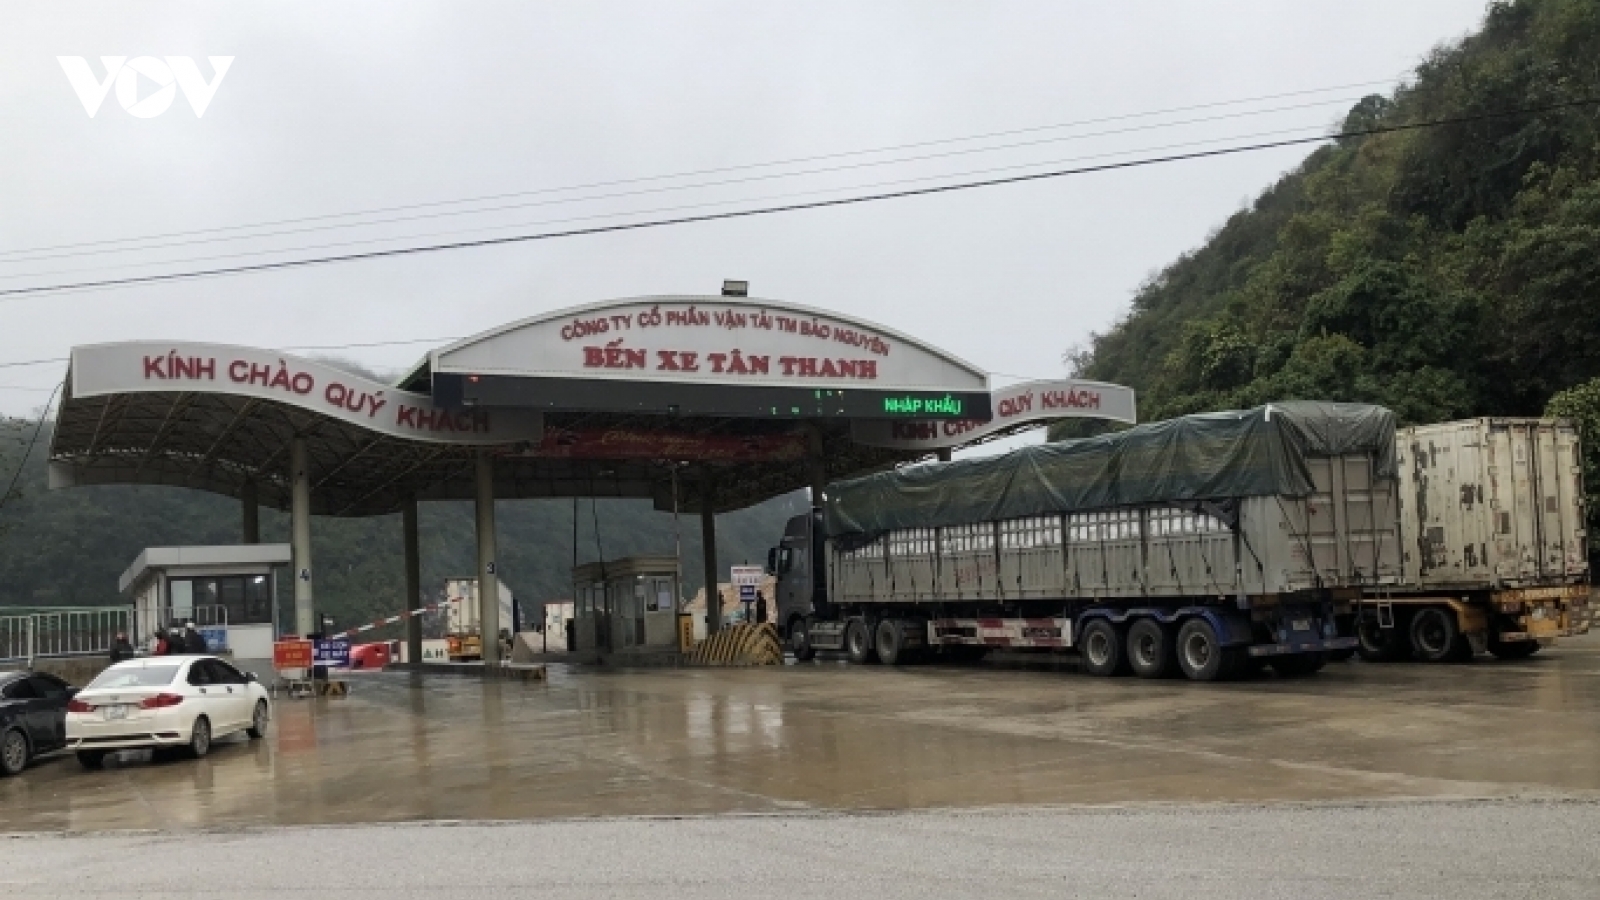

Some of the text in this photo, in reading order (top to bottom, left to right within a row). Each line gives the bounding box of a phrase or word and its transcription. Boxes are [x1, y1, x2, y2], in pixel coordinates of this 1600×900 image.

[561, 315, 609, 342] CÔNG
[610, 314, 632, 331] TY
[714, 309, 746, 330] VẬN
[750, 310, 773, 330] TẢI
[775, 315, 797, 333] TM
[800, 317, 831, 339] BẢO
[583, 337, 878, 380] BẾN XE TÂN THANH
[143, 348, 217, 380] KÍNH
[228, 358, 315, 395] CHÀO
[325, 382, 386, 418] QUÝ
[997, 388, 1034, 418] QUÝ
[1041, 386, 1101, 410] KHÁCH
